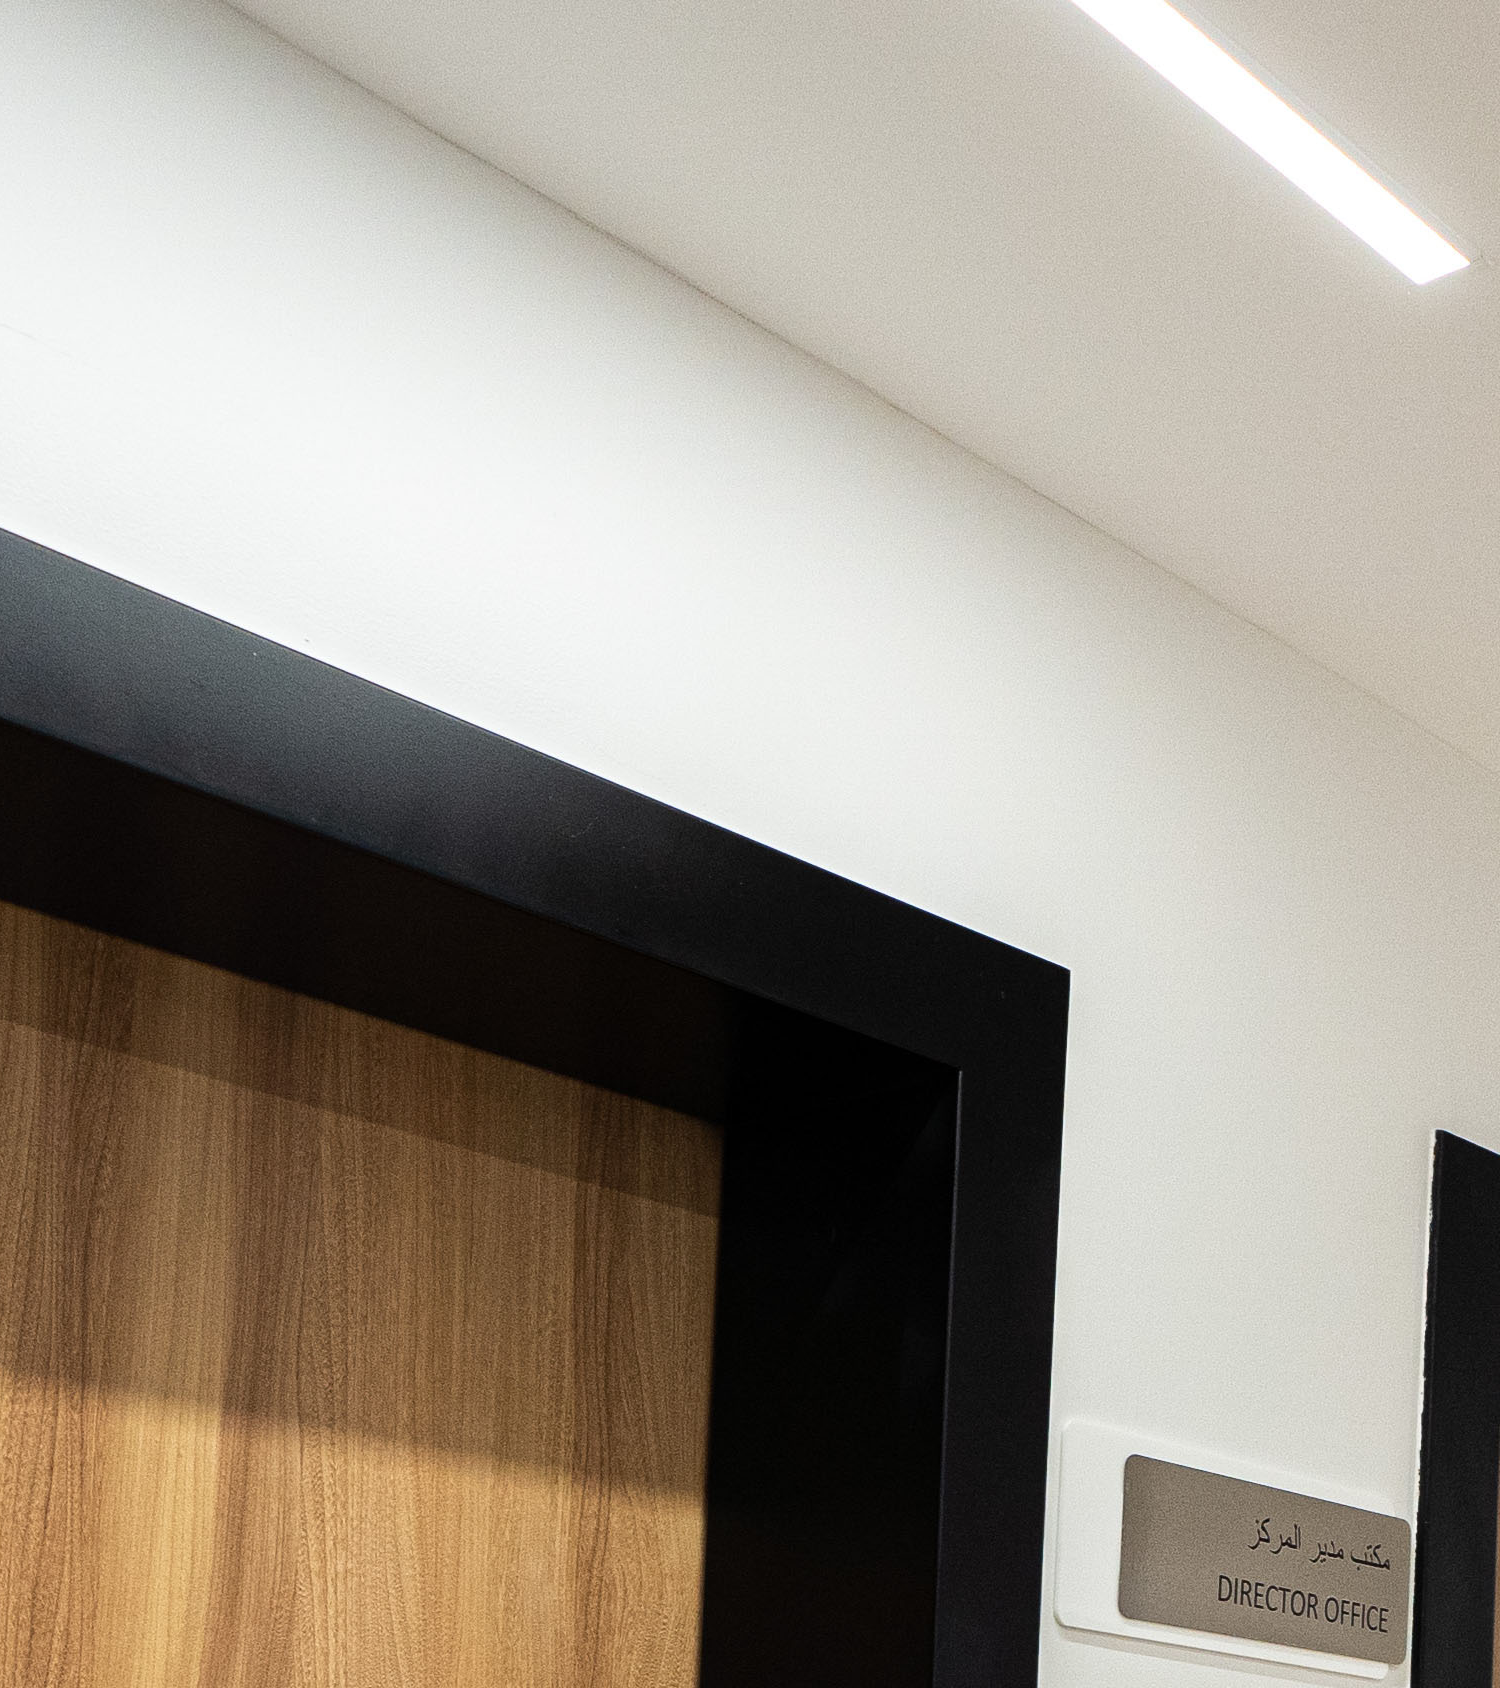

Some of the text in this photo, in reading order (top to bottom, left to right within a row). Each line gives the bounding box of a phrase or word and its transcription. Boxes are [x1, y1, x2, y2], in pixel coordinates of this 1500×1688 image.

[1247, 1517, 1391, 1571] مكتب مدير المركز
[1217, 1574, 1389, 1633] DIRECTOR OFFICE
